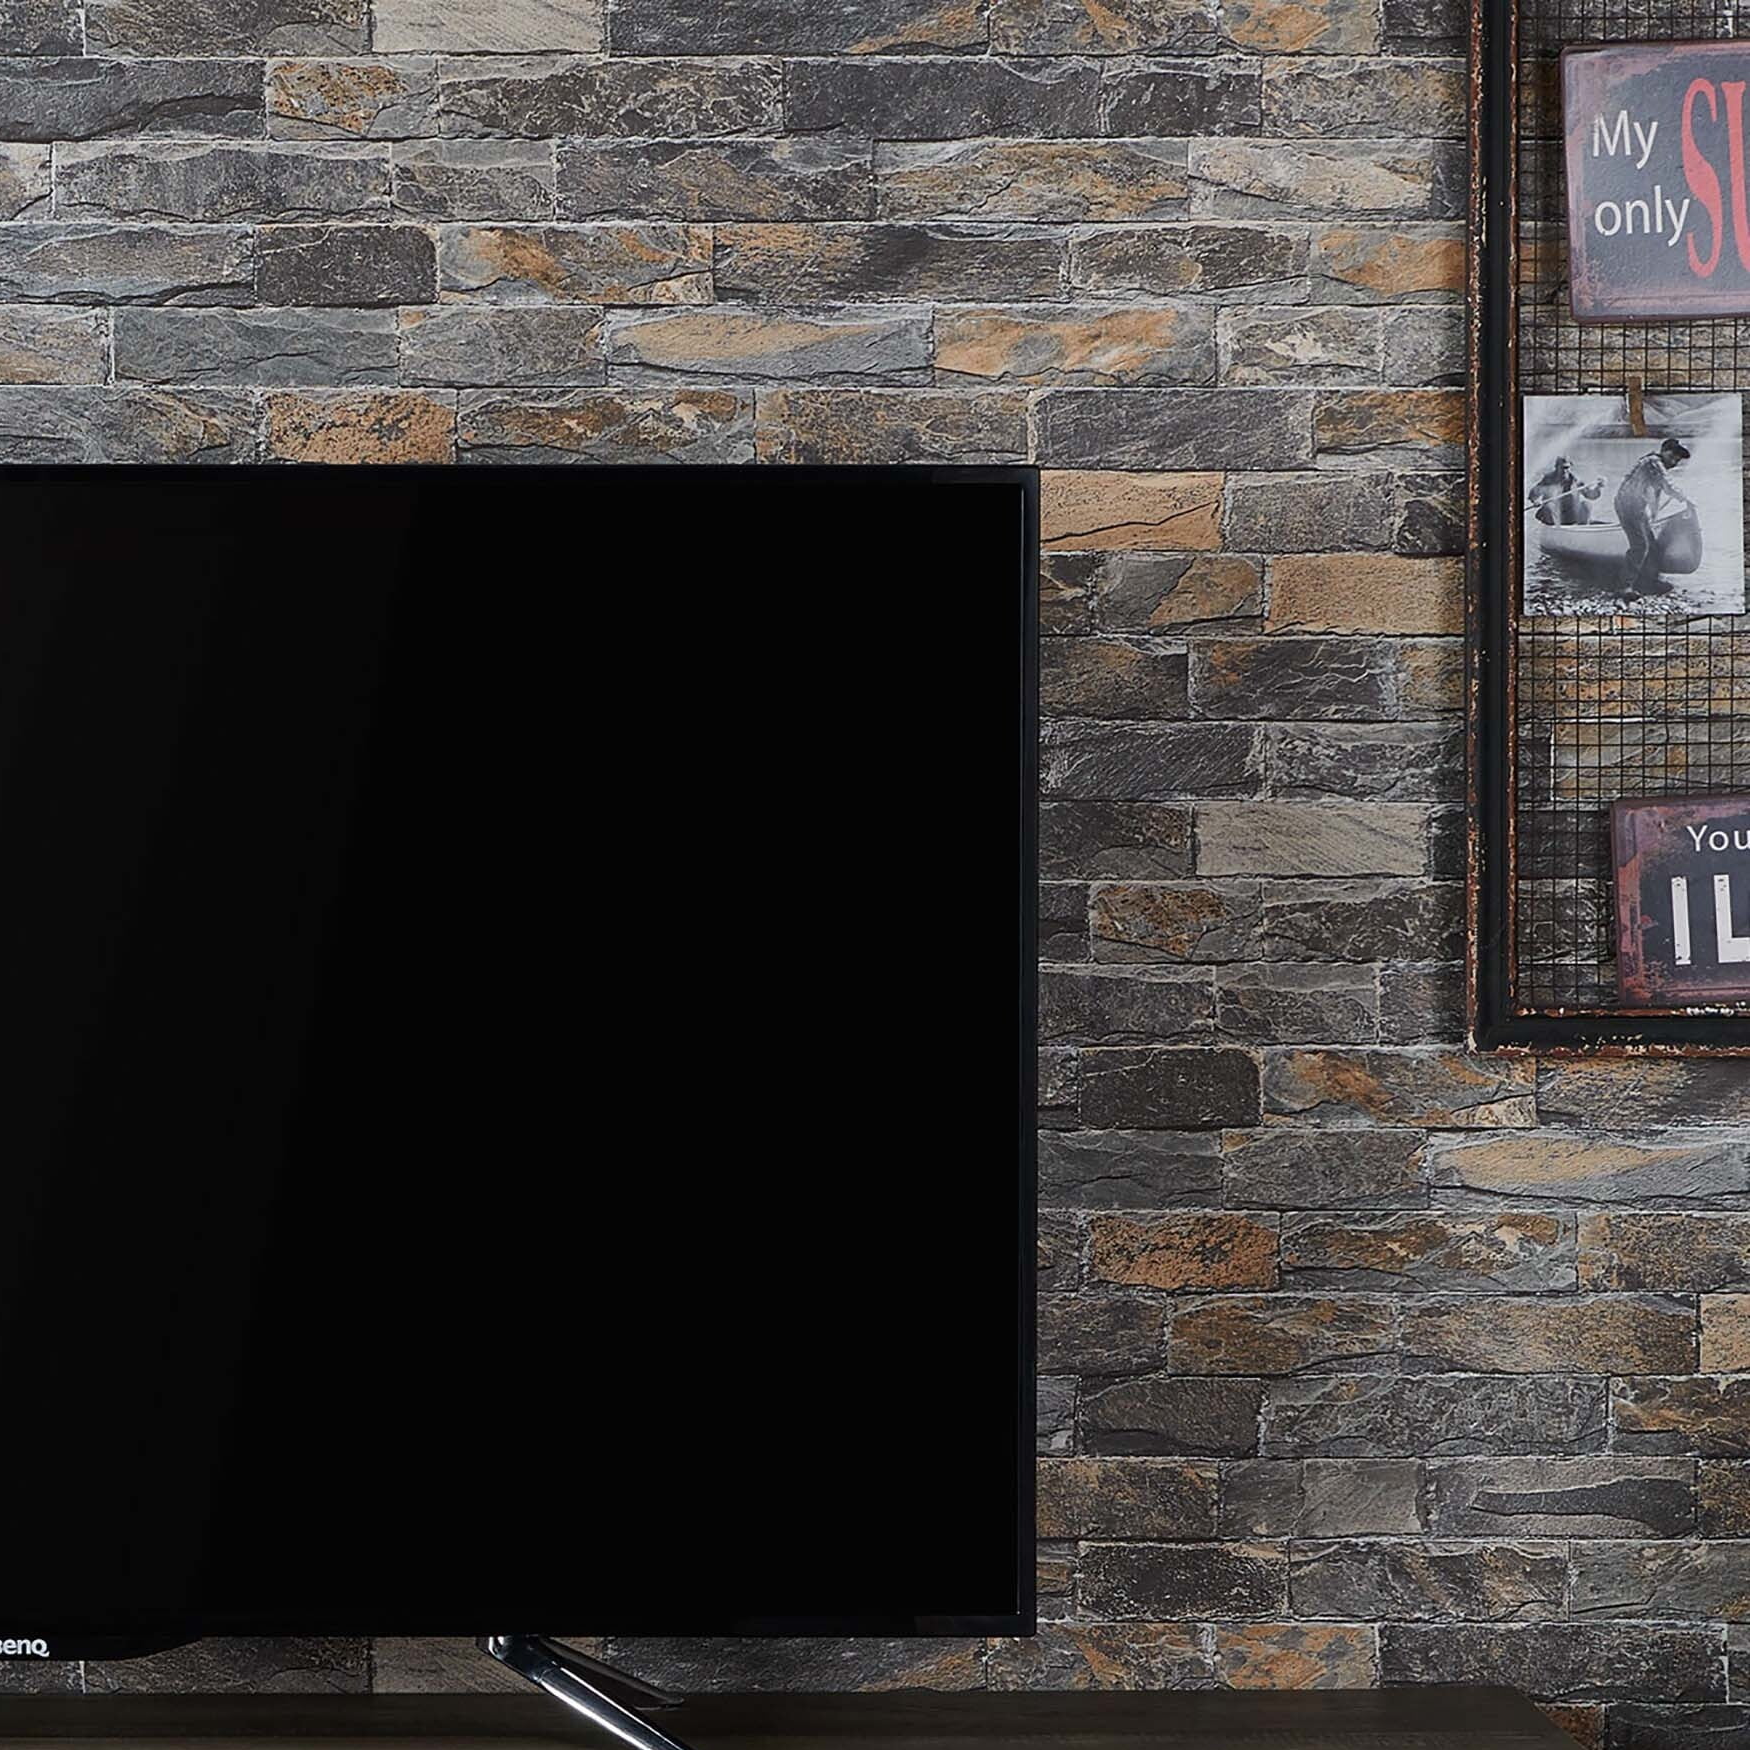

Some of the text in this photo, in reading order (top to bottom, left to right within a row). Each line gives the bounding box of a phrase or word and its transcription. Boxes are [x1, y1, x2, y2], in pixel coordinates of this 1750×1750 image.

[1592, 110, 1659, 170] My
[1594, 185, 1691, 248] only
[1686, 824, 1750, 852] You
